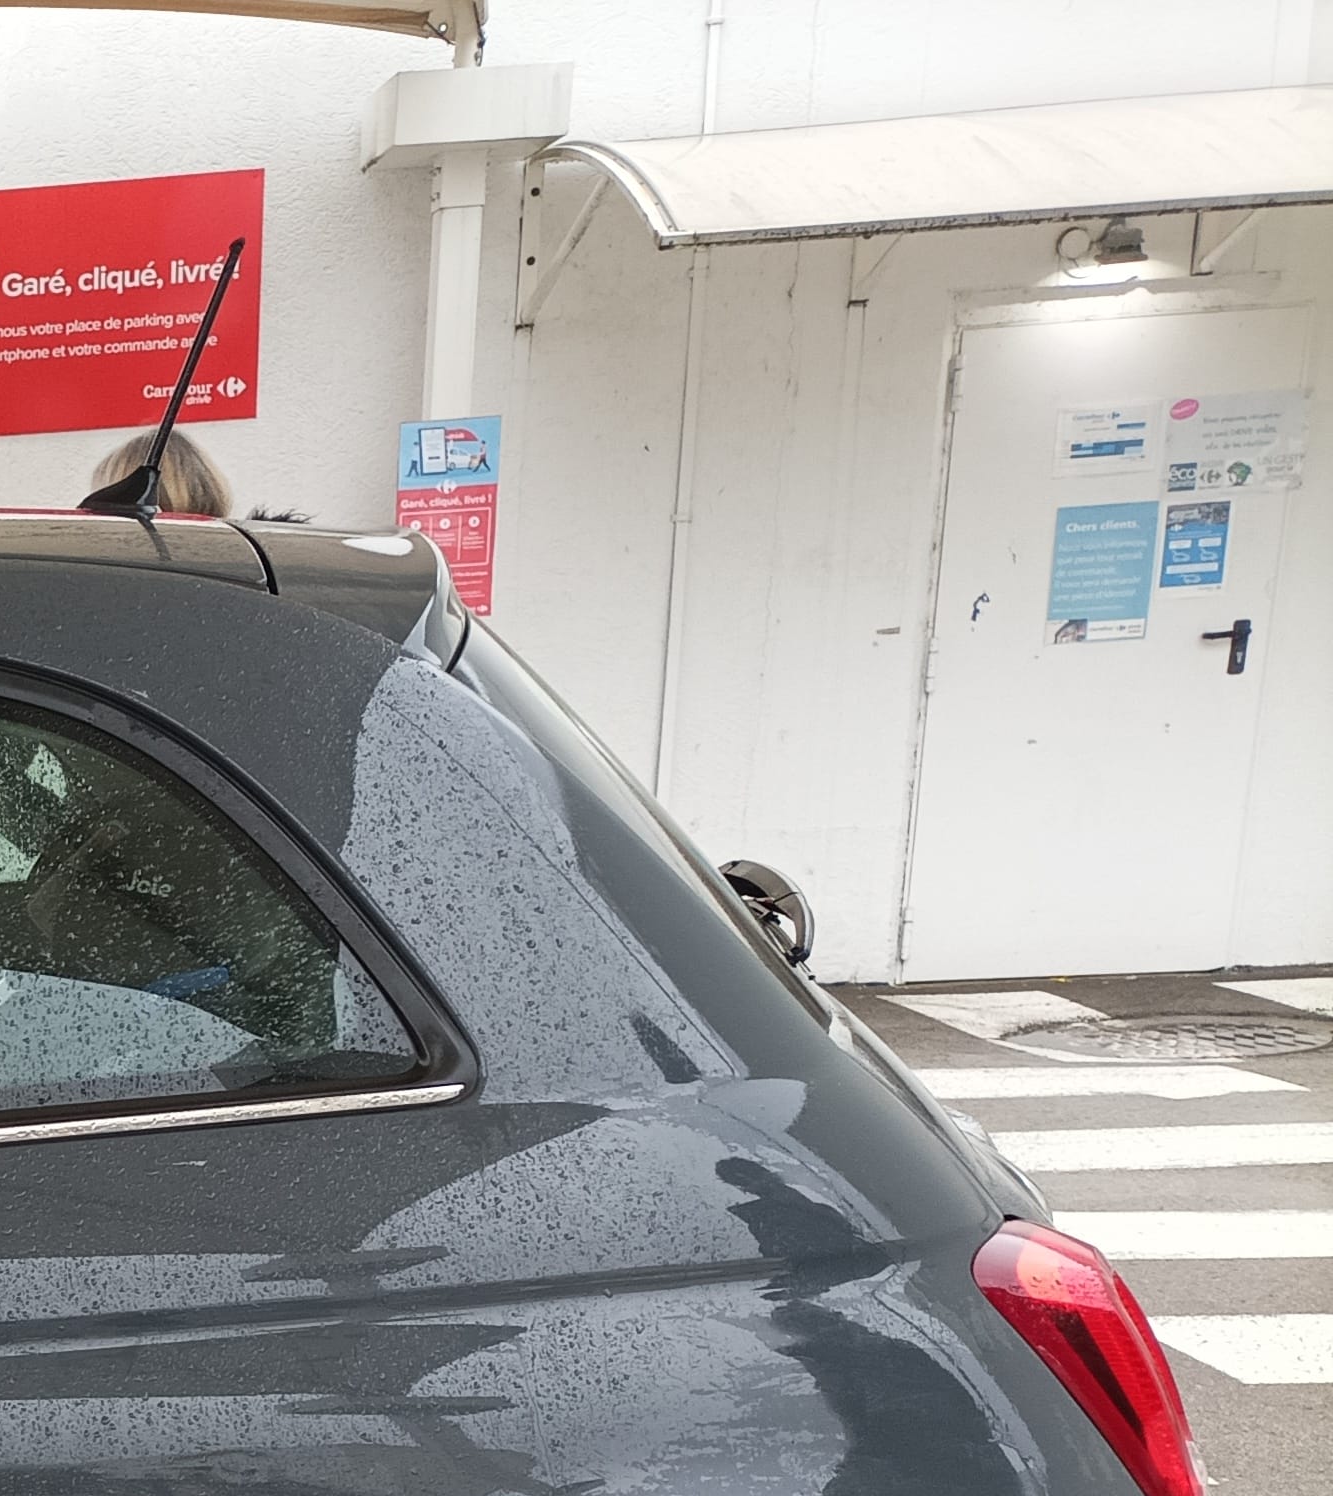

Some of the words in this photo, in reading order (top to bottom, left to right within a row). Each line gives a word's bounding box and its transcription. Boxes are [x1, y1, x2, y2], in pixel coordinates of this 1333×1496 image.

[2, 269, 72, 297] Garé,
[78, 261, 164, 294] cliqué,
[170, 256, 224, 284] livré
[30, 322, 63, 335] votre
[66, 320, 102, 335] place
[104, 317, 122, 330] de
[124, 313, 173, 331] parking
[52, 345, 66, 357] et
[68, 343, 102, 357] votre
[104, 337, 178, 353] commande
[180, 335, 218, 348] arve
[143, 383, 213, 398] Carrour
[1065, 521, 1097, 534] Chers
